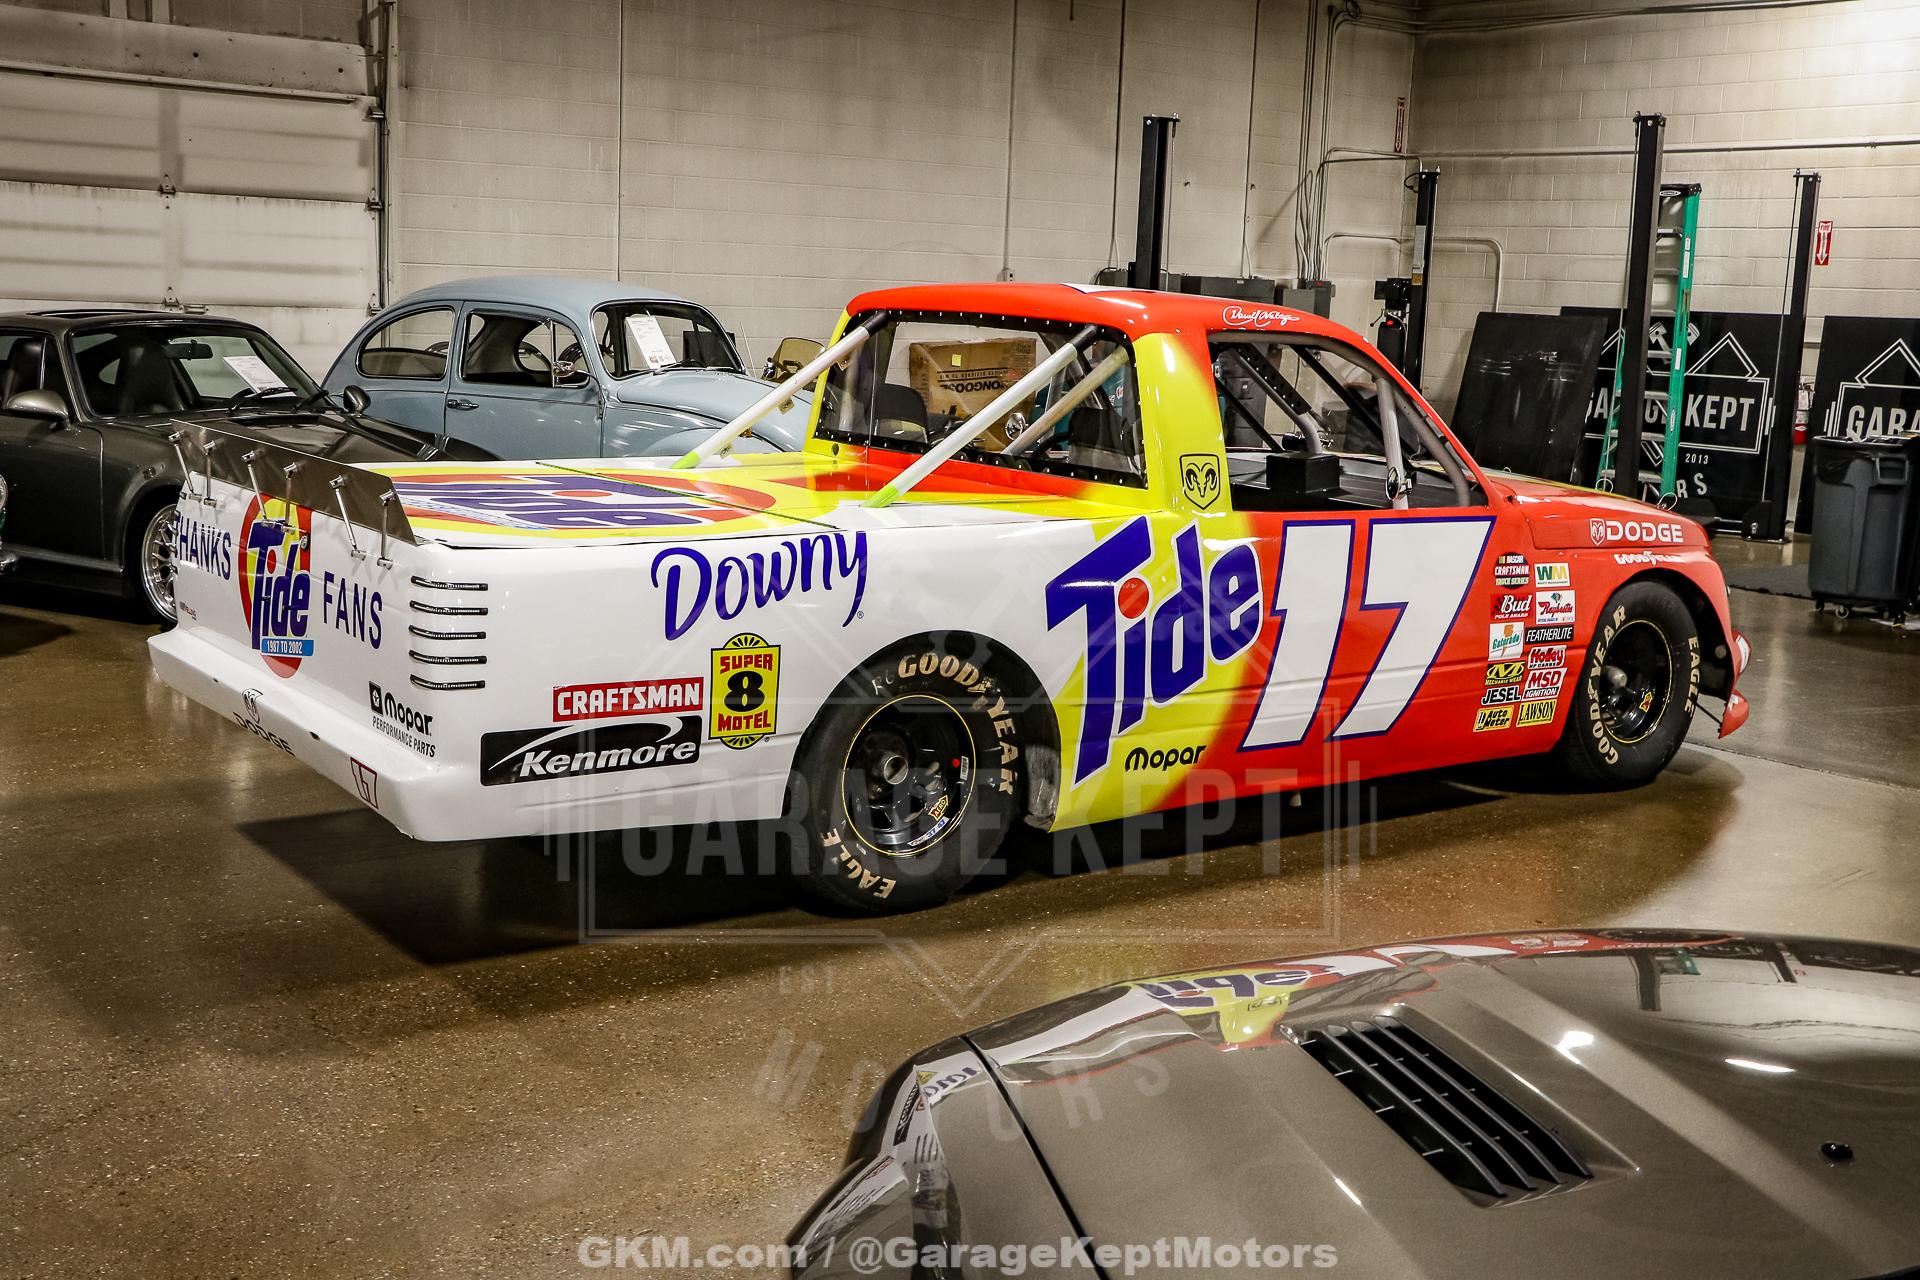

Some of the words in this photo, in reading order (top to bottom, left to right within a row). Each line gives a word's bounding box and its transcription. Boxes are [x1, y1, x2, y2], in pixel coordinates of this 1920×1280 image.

[1684, 393, 1755, 432] KEPT
[1685, 453, 1709, 465] 2013
[1606, 521, 1684, 543] DODGE
[247, 519, 311, 650] Tide
[650, 531, 868, 641] Downy
[1494, 565, 1530, 576] CRAFTSMAN
[1536, 566, 1568, 581] WM
[323, 570, 383, 650] FANS
[1500, 594, 1533, 613] Bud
[280, 640, 288, 654] TO
[1045, 515, 1263, 786] Tide
[1237, 515, 1498, 753] 17
[1525, 627, 1573, 642] FEATHERLITE
[719, 653, 774, 675] SUPER
[1528, 671, 1562, 689] MSD
[1684, 636, 1701, 714] EAGLE
[556, 681, 701, 717] CRAFTSMAN
[723, 670, 766, 712] 8
[1482, 686, 1521, 704] JESEL
[1525, 688, 1557, 699] IGNITION
[1587, 605, 1627, 765] GOODYEAR
[384, 692, 434, 737] Mopar
[716, 709, 772, 731] MOTEL
[897, 651, 1019, 796] GOODYEAR
[1487, 709, 1508, 719] Auto
[1519, 701, 1556, 721] LAWSON
[232, 711, 296, 758] DODGE
[372, 715, 413, 751] PERFORMANCE
[413, 740, 437, 758] PARTS
[519, 737, 697, 778] Kenmore
[1124, 744, 1207, 773] Mopar
[821, 827, 897, 899] EAGLE
